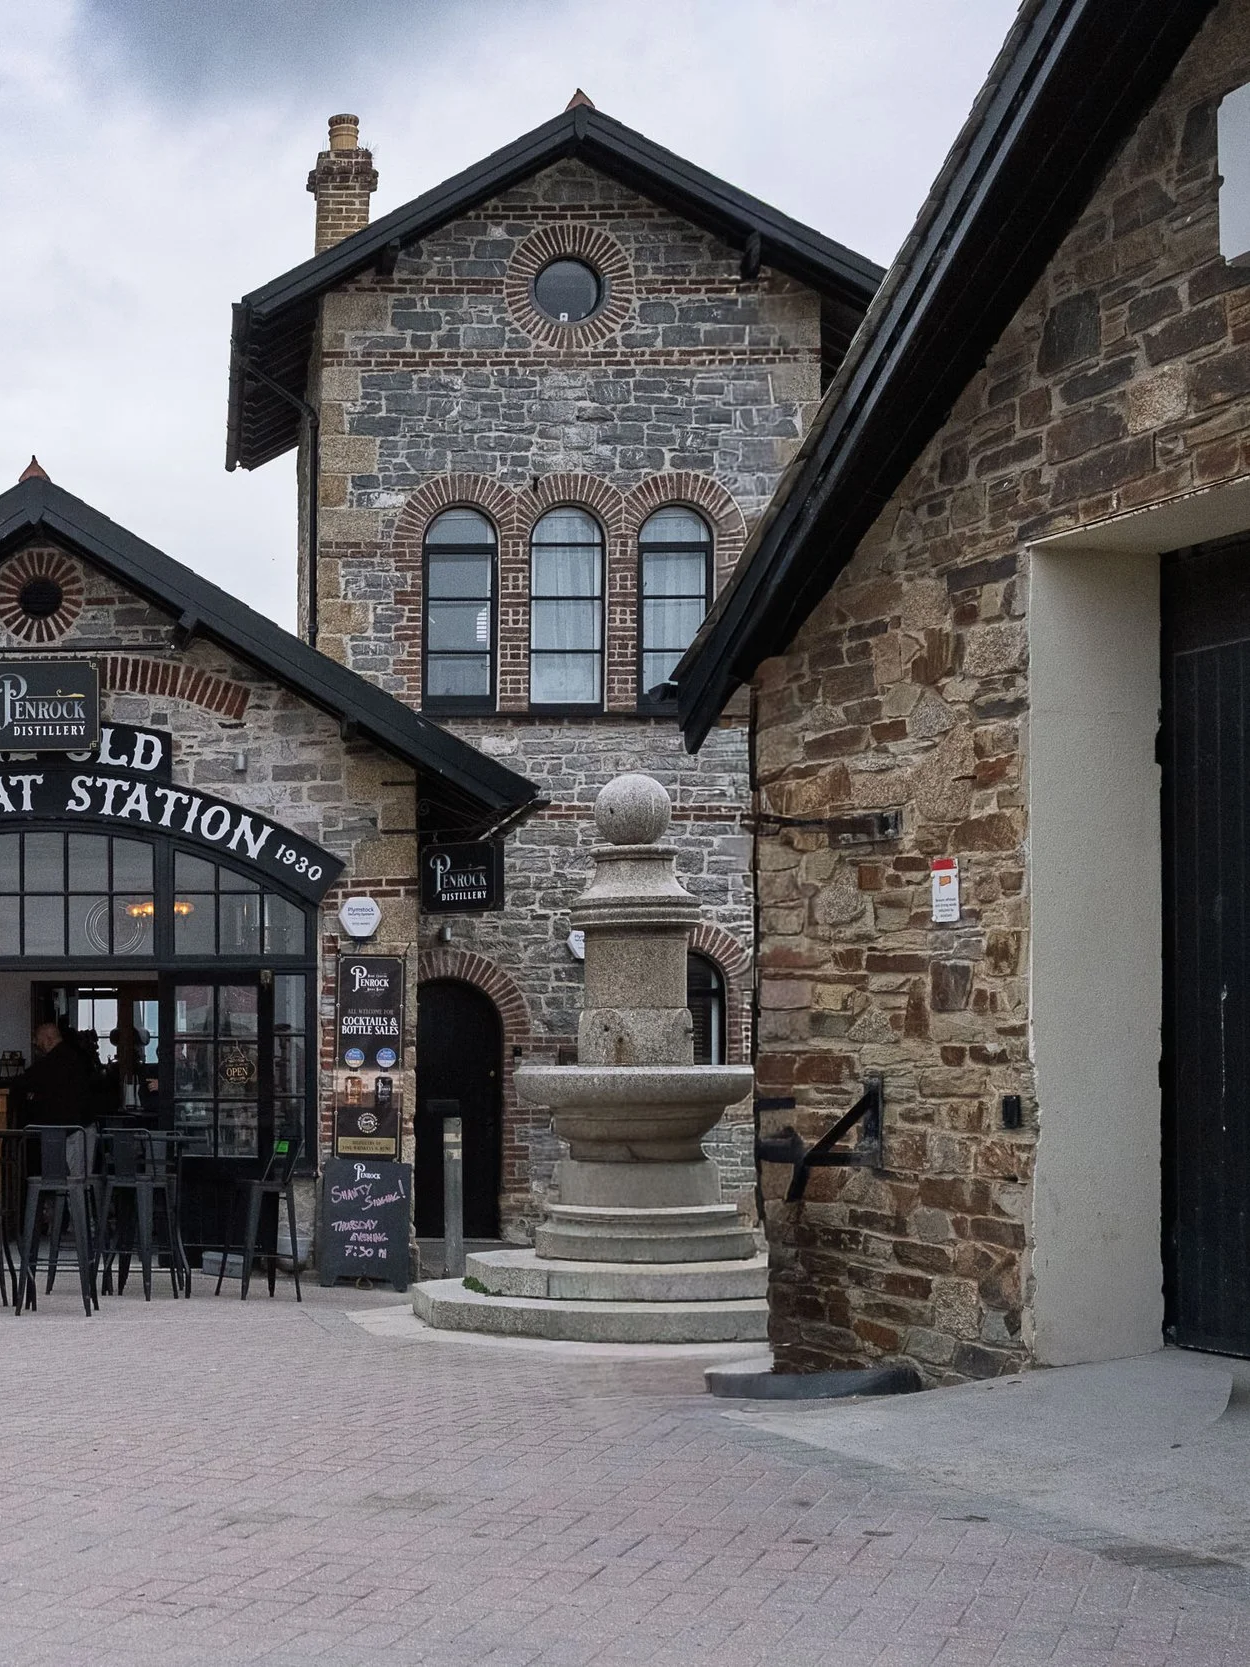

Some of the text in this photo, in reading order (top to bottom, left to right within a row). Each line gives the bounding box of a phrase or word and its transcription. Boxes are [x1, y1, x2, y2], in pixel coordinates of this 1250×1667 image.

[13, 725, 86, 736] DISTILLERY
[65, 728, 164, 771] LD
[65, 775, 276, 860] STATION
[274, 844, 323, 881] 1930
[429, 852, 487, 898] PENROCK
[441, 890, 487, 902] DISTILLERY
[350, 965, 390, 993] PENROCK
[342, 1016, 399, 1026] COCKTAILS &
[341, 1025, 399, 1036] BOTTLE SALES
[226, 1067, 248, 1076] OPEN
[353, 1162, 381, 1182] PENROCK
[331, 1219, 379, 1232] THURSDAY
[350, 1232, 389, 1243] EVENING
[344, 1244, 374, 1258] 7:30
